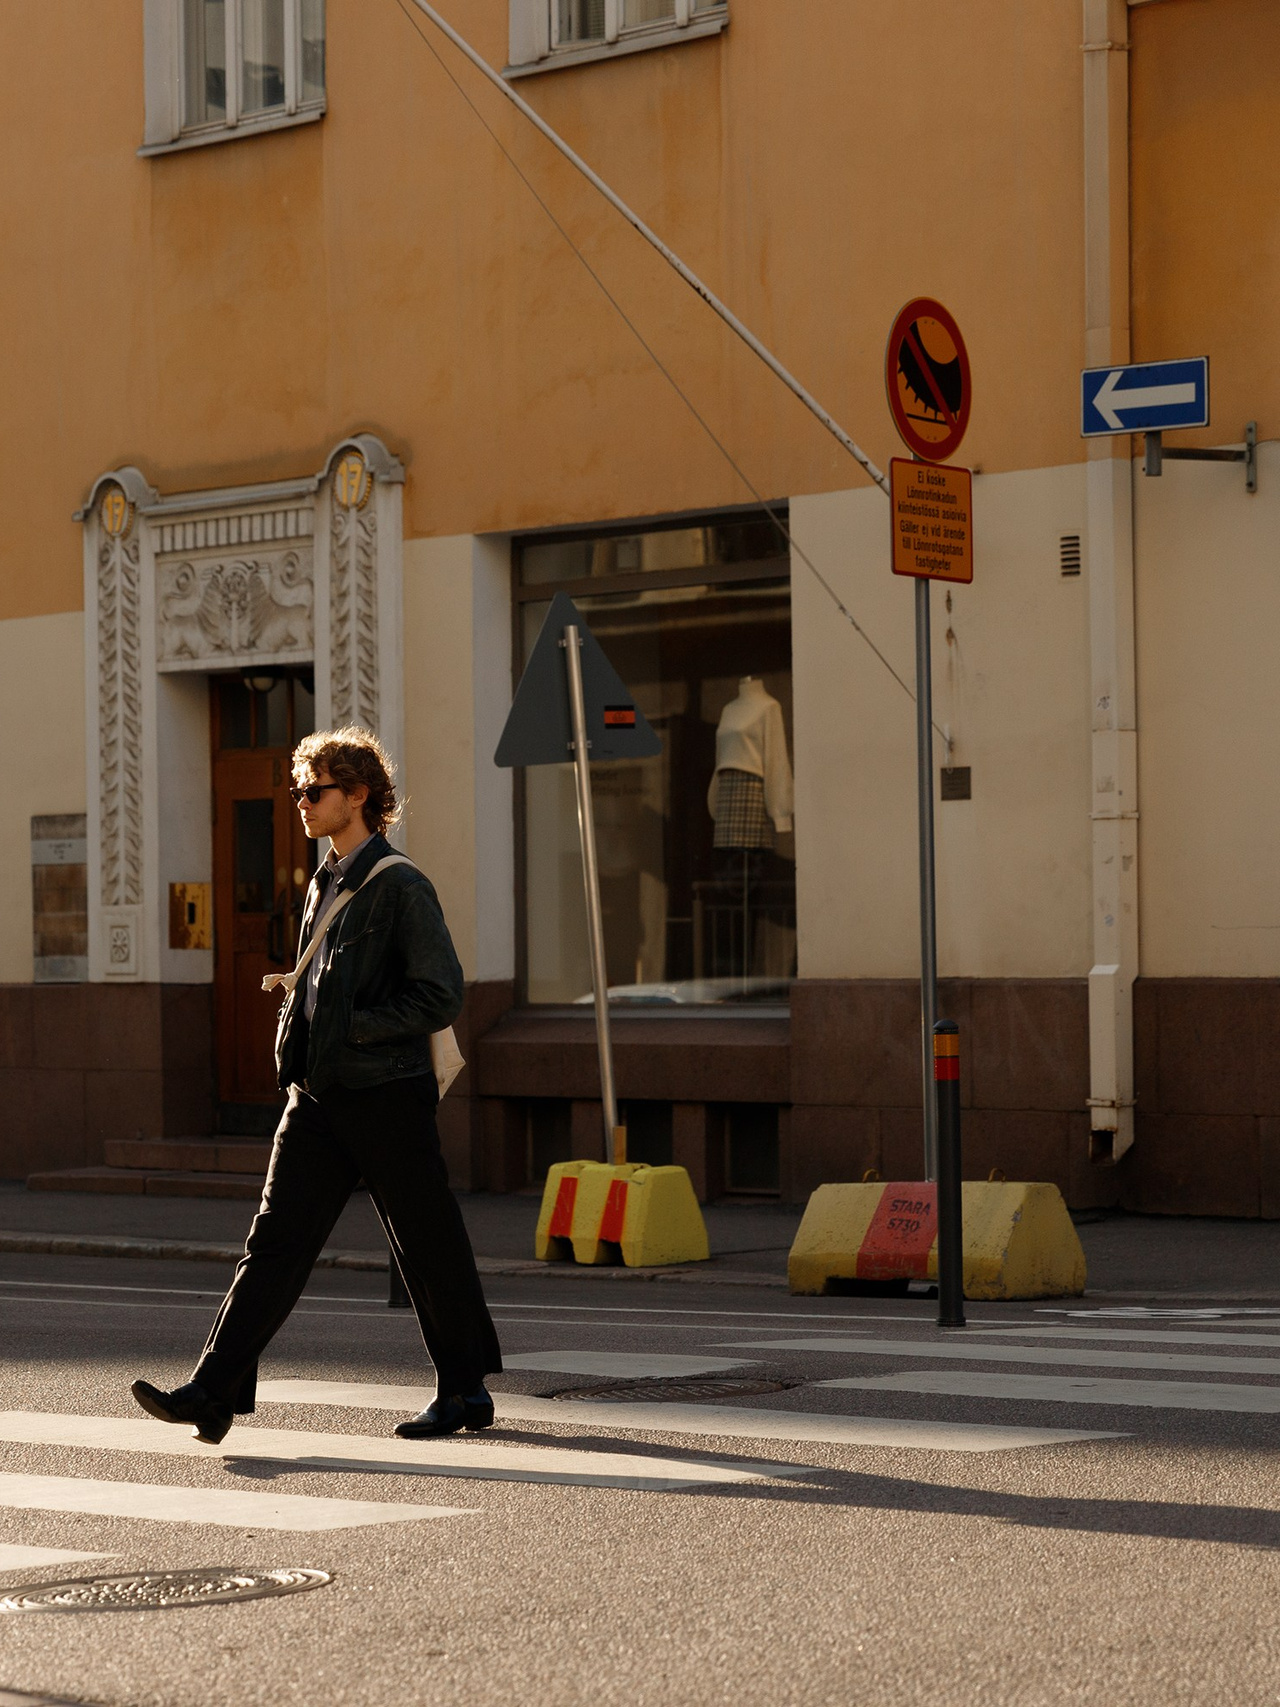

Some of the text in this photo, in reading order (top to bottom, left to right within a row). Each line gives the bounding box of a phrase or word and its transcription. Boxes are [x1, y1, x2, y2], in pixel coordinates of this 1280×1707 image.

[337, 461, 364, 506] 17
[917, 470, 925, 484] Ei
[105, 492, 125, 534] 17
[890, 1199, 931, 1216] STARA
[886, 1217, 920, 1233] 5730
